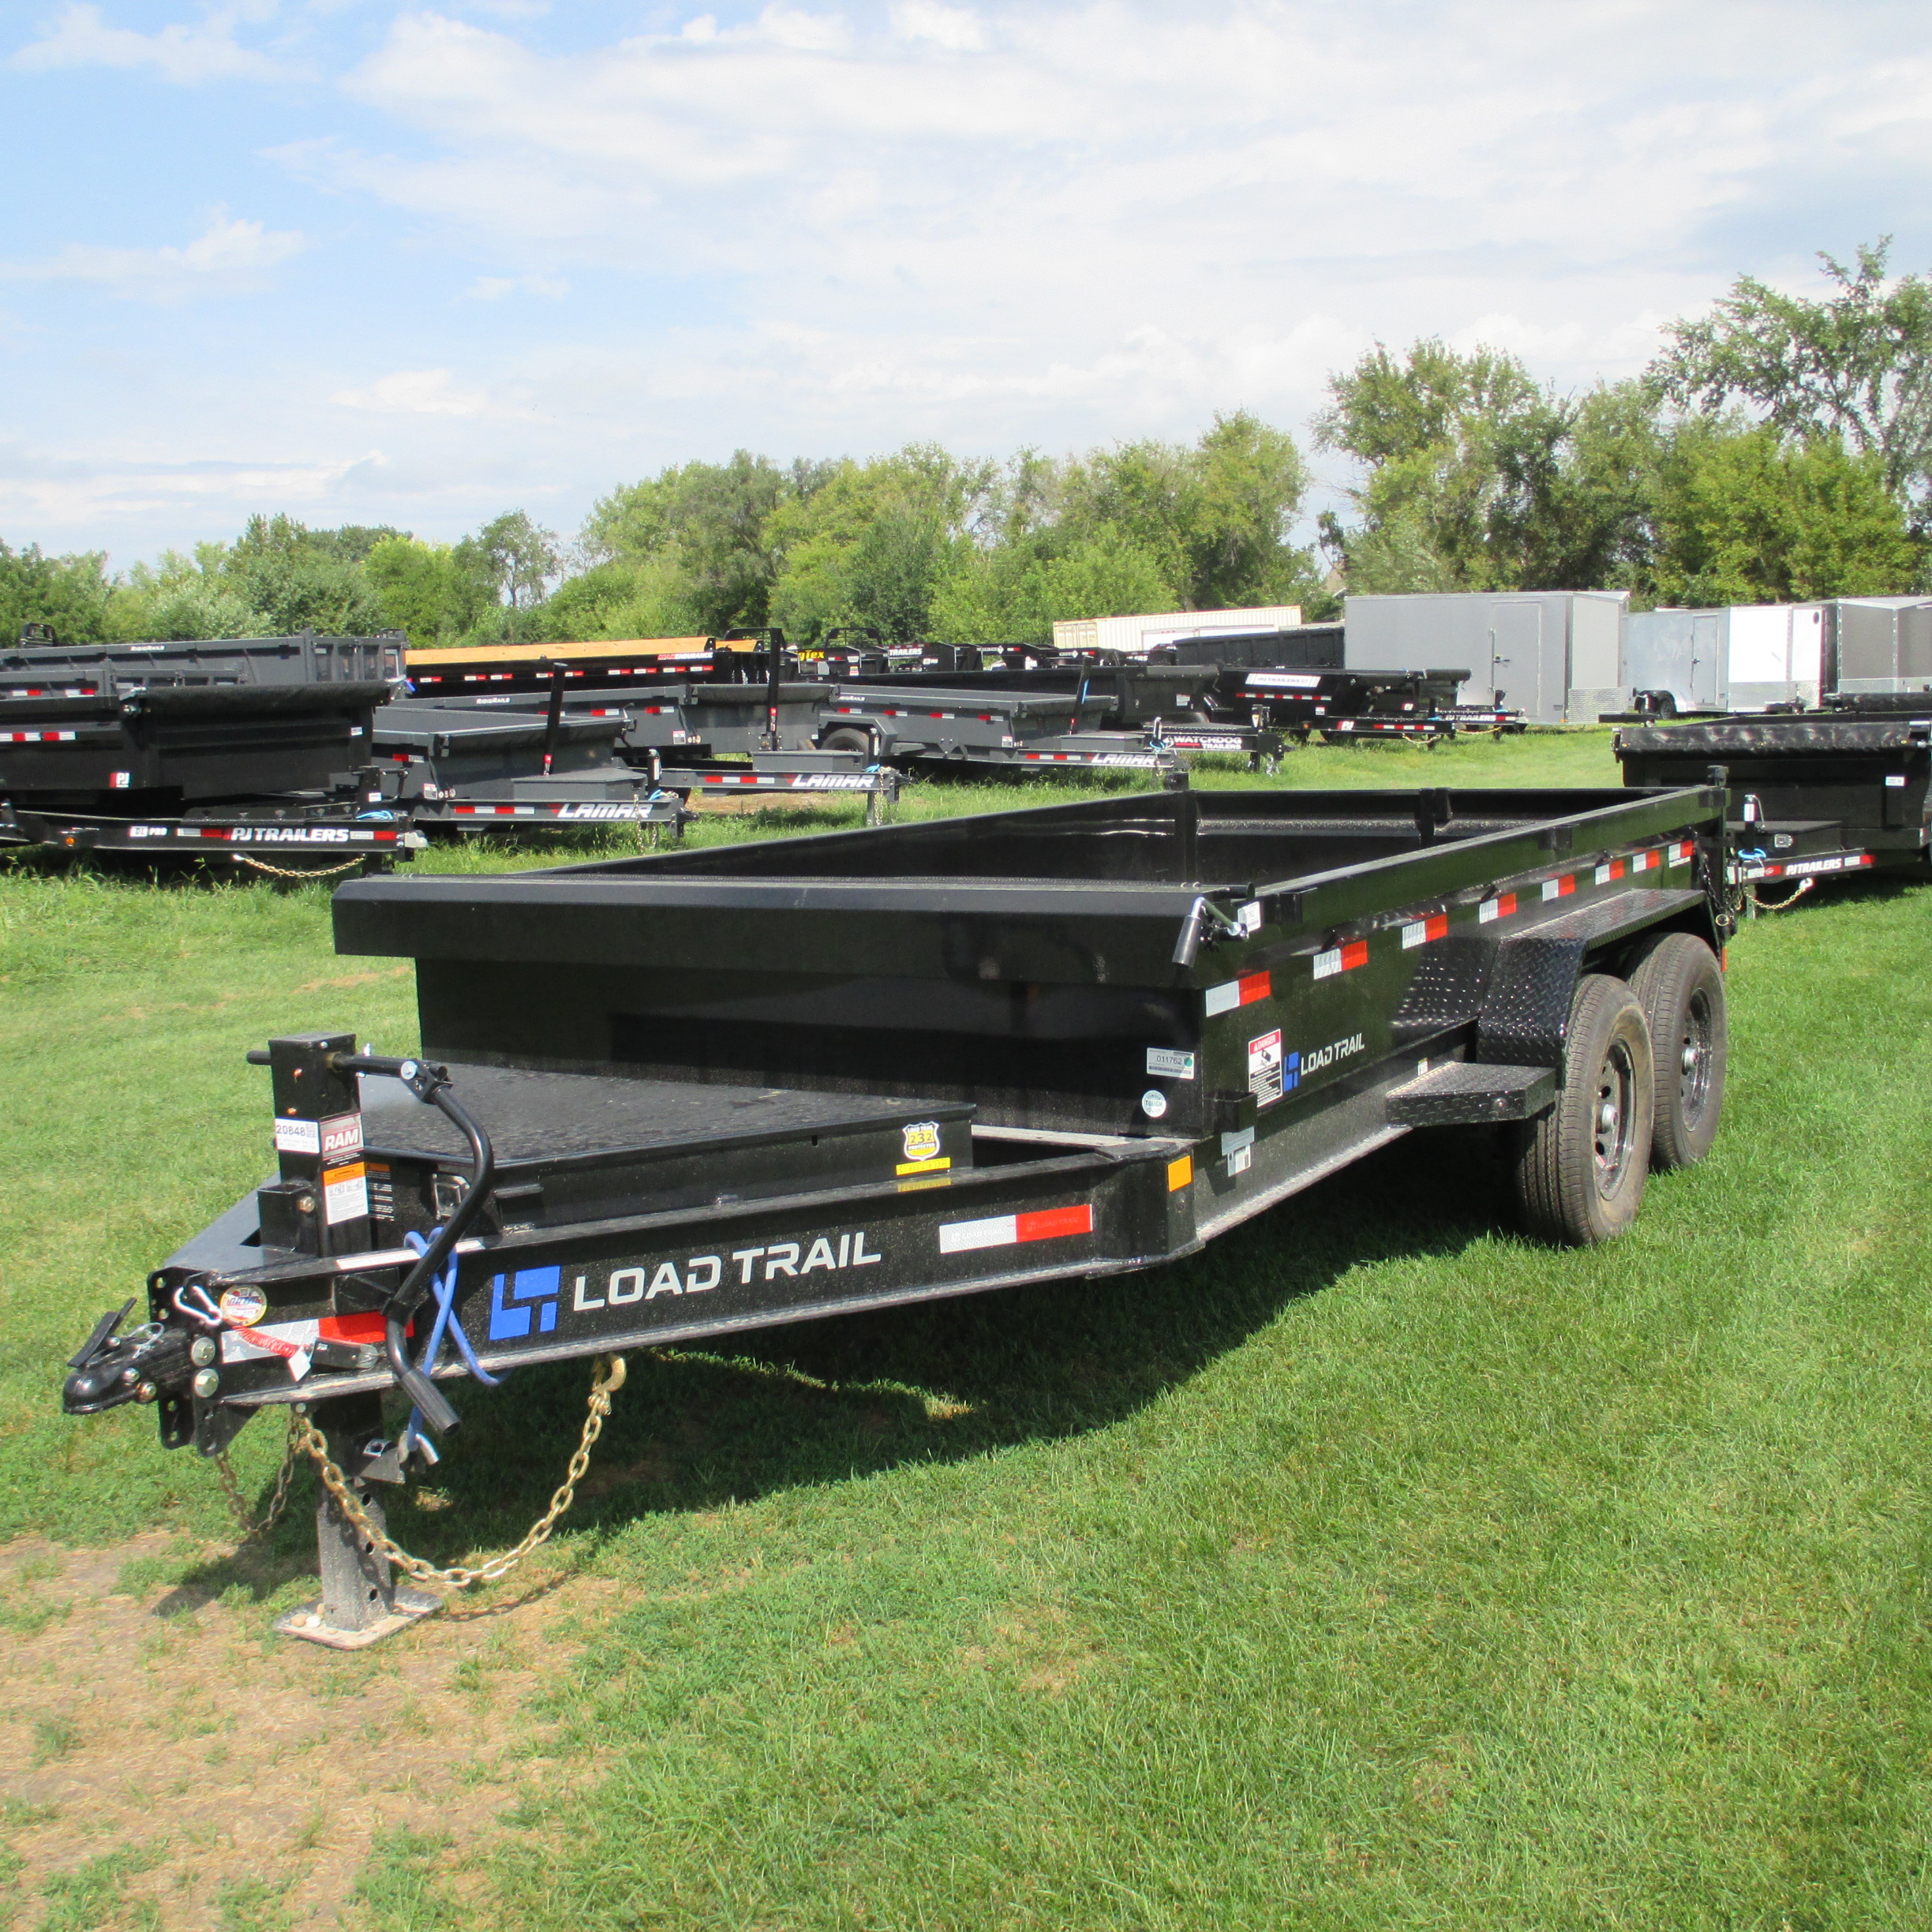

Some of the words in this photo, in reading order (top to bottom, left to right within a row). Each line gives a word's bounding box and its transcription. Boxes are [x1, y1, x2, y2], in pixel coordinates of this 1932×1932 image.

[889, 648, 923, 657] TRAILERS
[1174, 736, 1243, 744] WATCHDOG
[115, 772, 130, 785] PJ
[792, 774, 875, 788] LAMAR
[557, 803, 653, 818] LAMAR
[148, 827, 168, 836] PRO
[230, 828, 253, 841] PJ
[254, 828, 350, 842] TRAILERS
[1785, 863, 1798, 876] PJ
[1797, 859, 1842, 872] TRAILERS
[1256, 1034, 1276, 1050] DANGER
[1156, 1055, 1182, 1065] 011762
[1301, 1045, 1332, 1076] LOAD
[1334, 1032, 1365, 1061] TRAIL
[276, 1125, 306, 1136] 20848
[324, 1128, 359, 1151] RAM
[910, 1133, 933, 1144] 232
[908, 1142, 936, 1151] PROTECTED
[573, 1255, 722, 1312] LOAD
[732, 1231, 882, 1284] TRAIL
